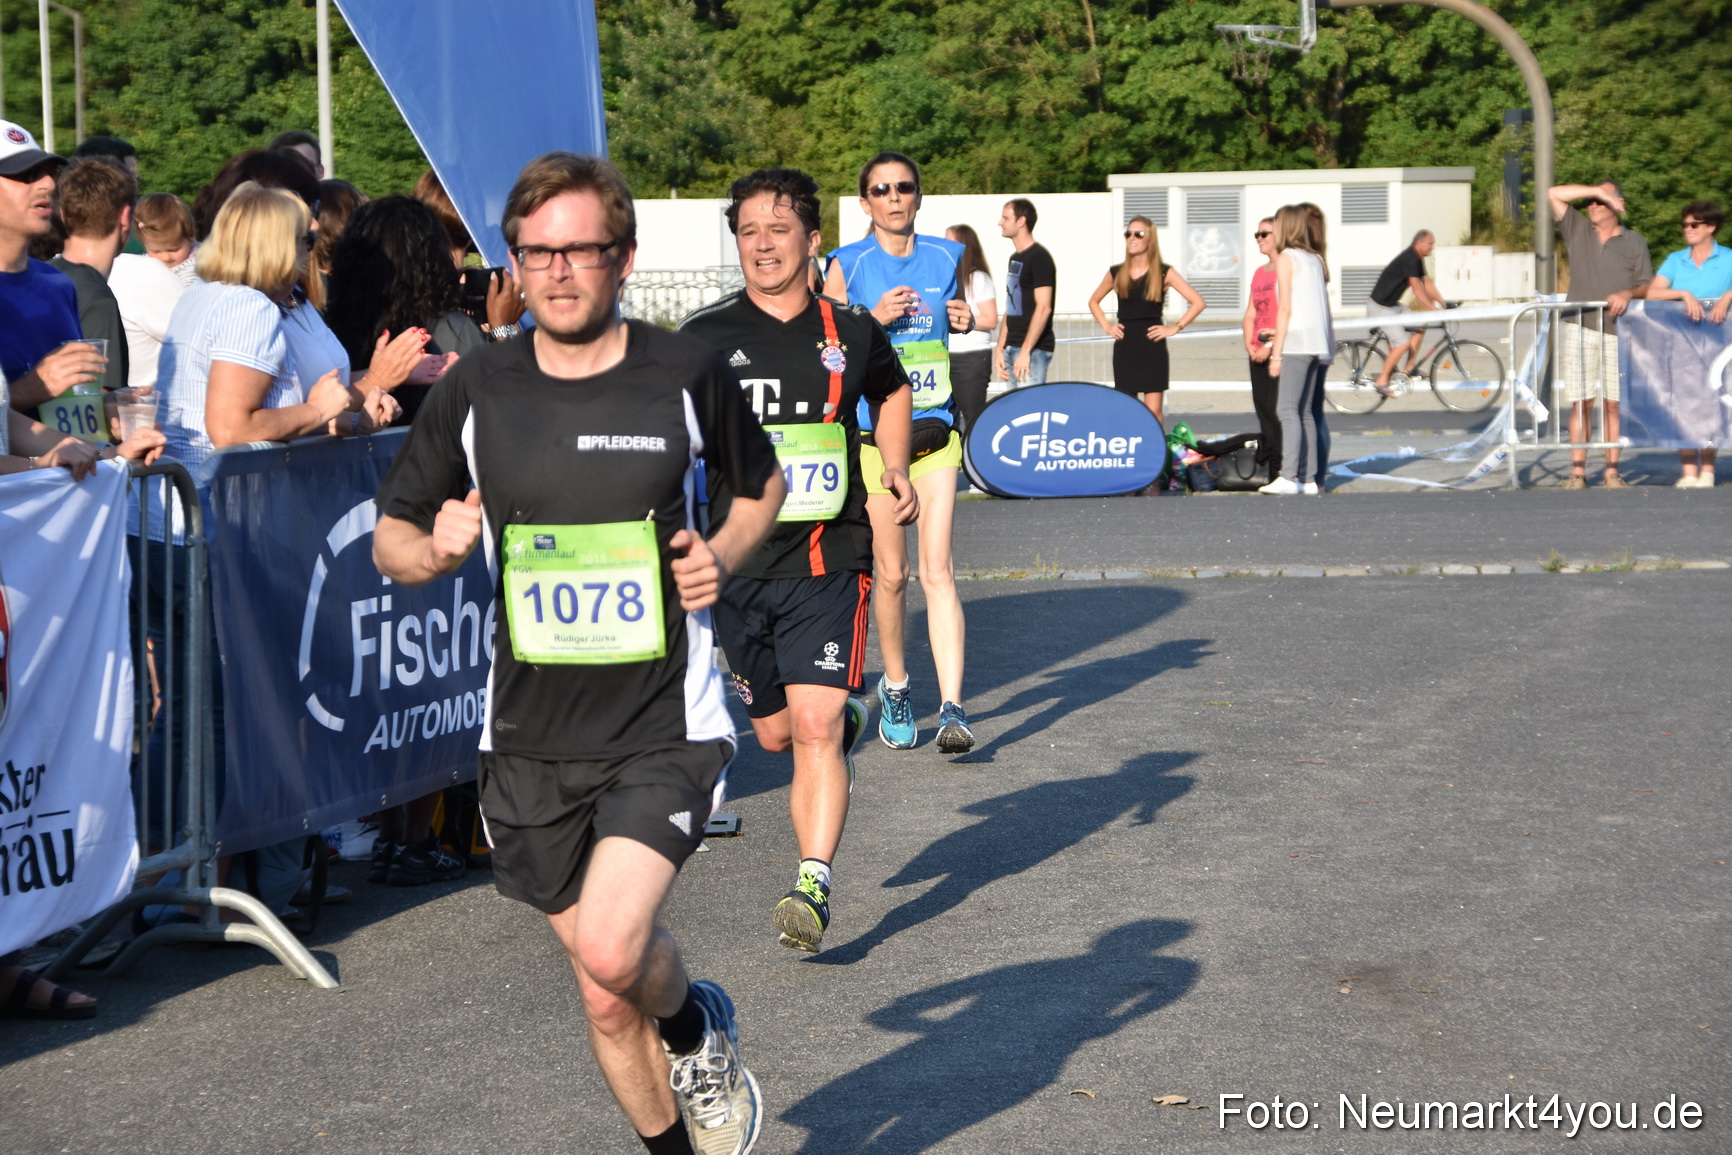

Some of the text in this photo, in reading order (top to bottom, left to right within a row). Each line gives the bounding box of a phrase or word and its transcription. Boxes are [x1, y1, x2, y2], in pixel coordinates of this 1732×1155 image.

[910, 369, 937, 393] 84
[55, 403, 99, 434] 816
[591, 435, 667, 453] PFLEIDERER
[1020, 431, 1143, 459] Fischer
[1034, 457, 1136, 472] AUTOMOBILE
[783, 462, 839, 493] 179
[524, 548, 576, 561] firmenlauf
[523, 581, 645, 624] 1078
[553, 633, 617, 644] Rüdiger Jürke
